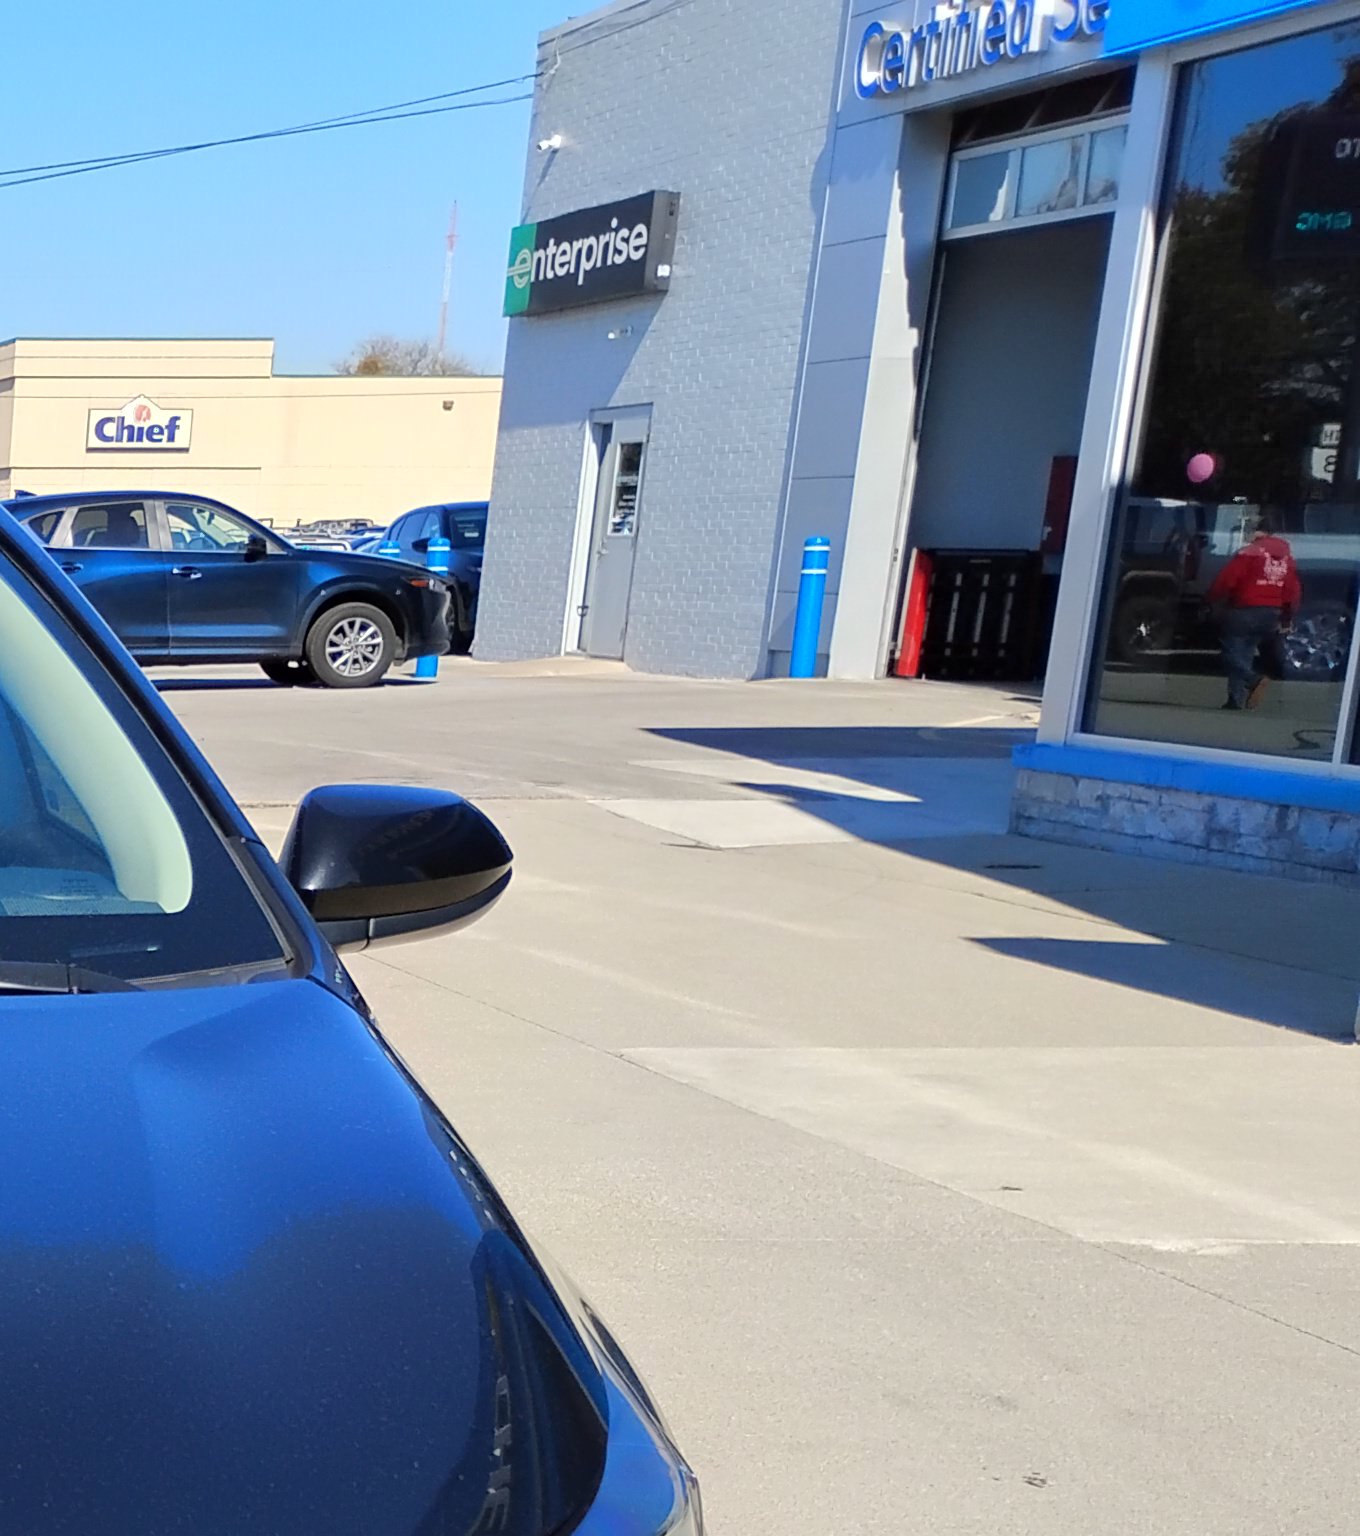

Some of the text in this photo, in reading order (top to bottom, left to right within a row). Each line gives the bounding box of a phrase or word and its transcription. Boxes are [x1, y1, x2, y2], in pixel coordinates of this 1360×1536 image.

[854, 0, 1035, 99] Certified
[507, 217, 648, 289] enterprise
[95, 415, 181, 443] Chief
